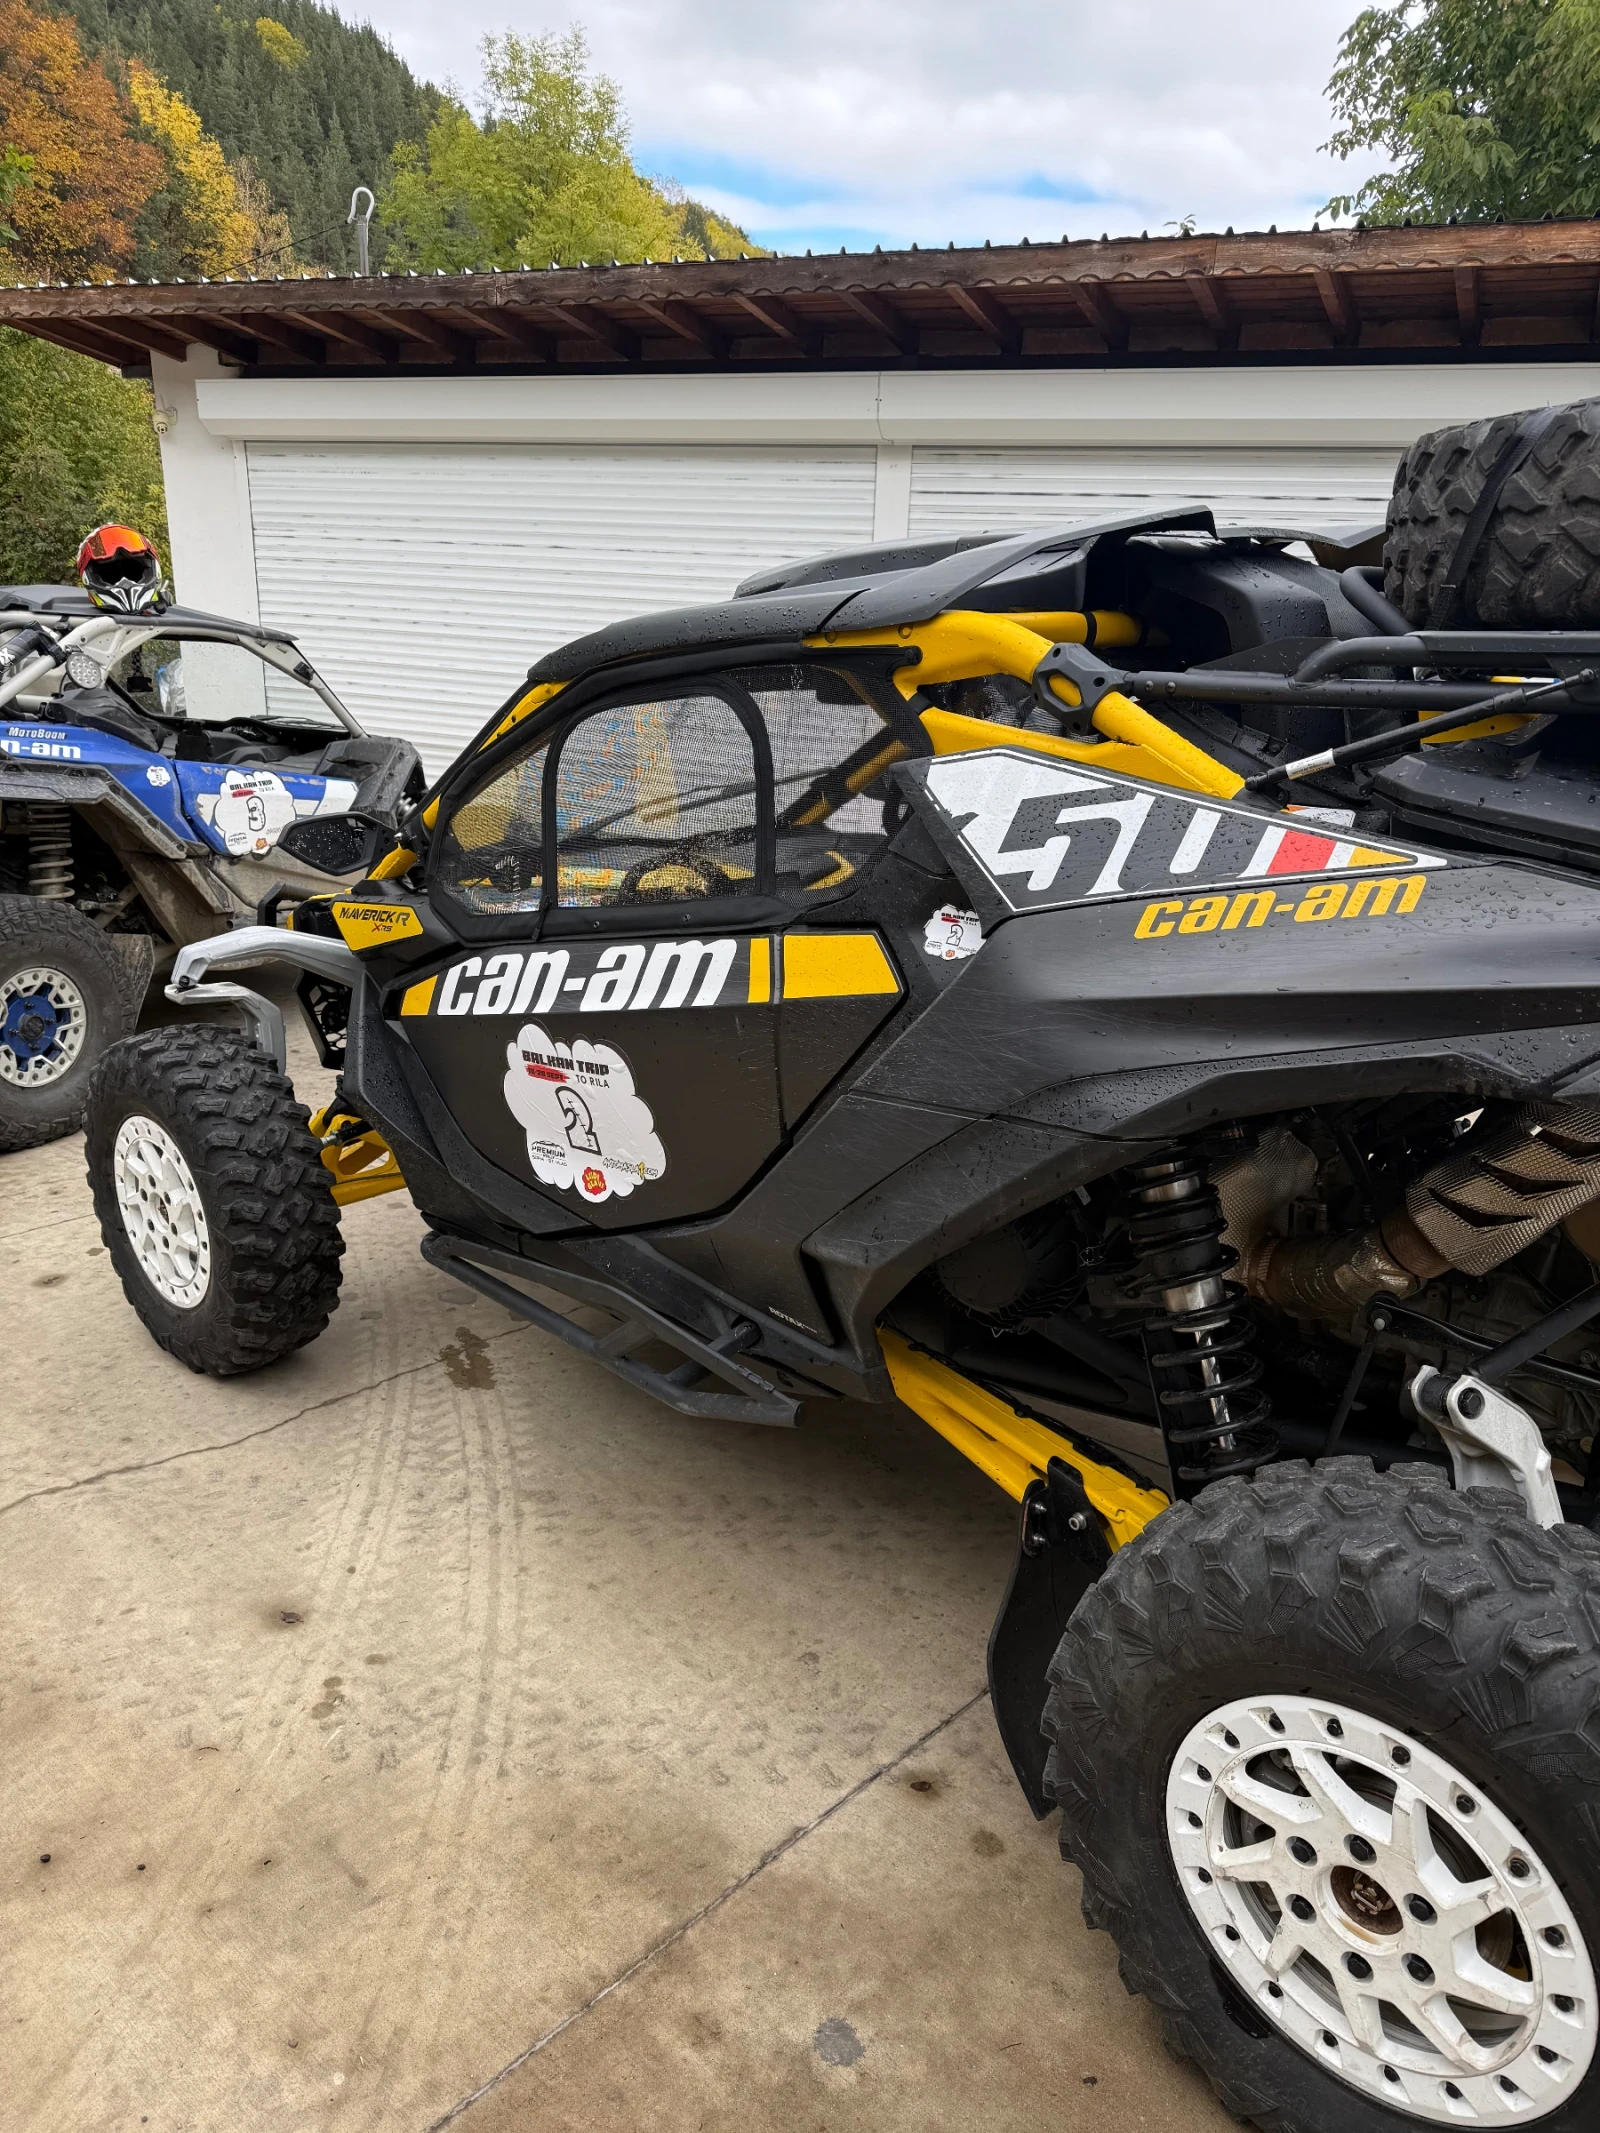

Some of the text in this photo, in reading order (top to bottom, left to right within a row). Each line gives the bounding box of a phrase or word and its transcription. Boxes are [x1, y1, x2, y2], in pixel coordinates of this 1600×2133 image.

[339, 907, 410, 926] MAVERICK R
[1134, 875, 1427, 940] can-am
[371, 923, 393, 932] XRS
[946, 924, 964, 947] 2
[436, 938, 737, 1017] can-am
[522, 1050, 610, 1076] BALKAN TRIP
[576, 1074, 610, 1089] TO RILA
[554, 1086, 603, 1157] 2
[531, 1146, 566, 1159] PREMIUM
[768, 1306, 805, 1330] ROTAX
